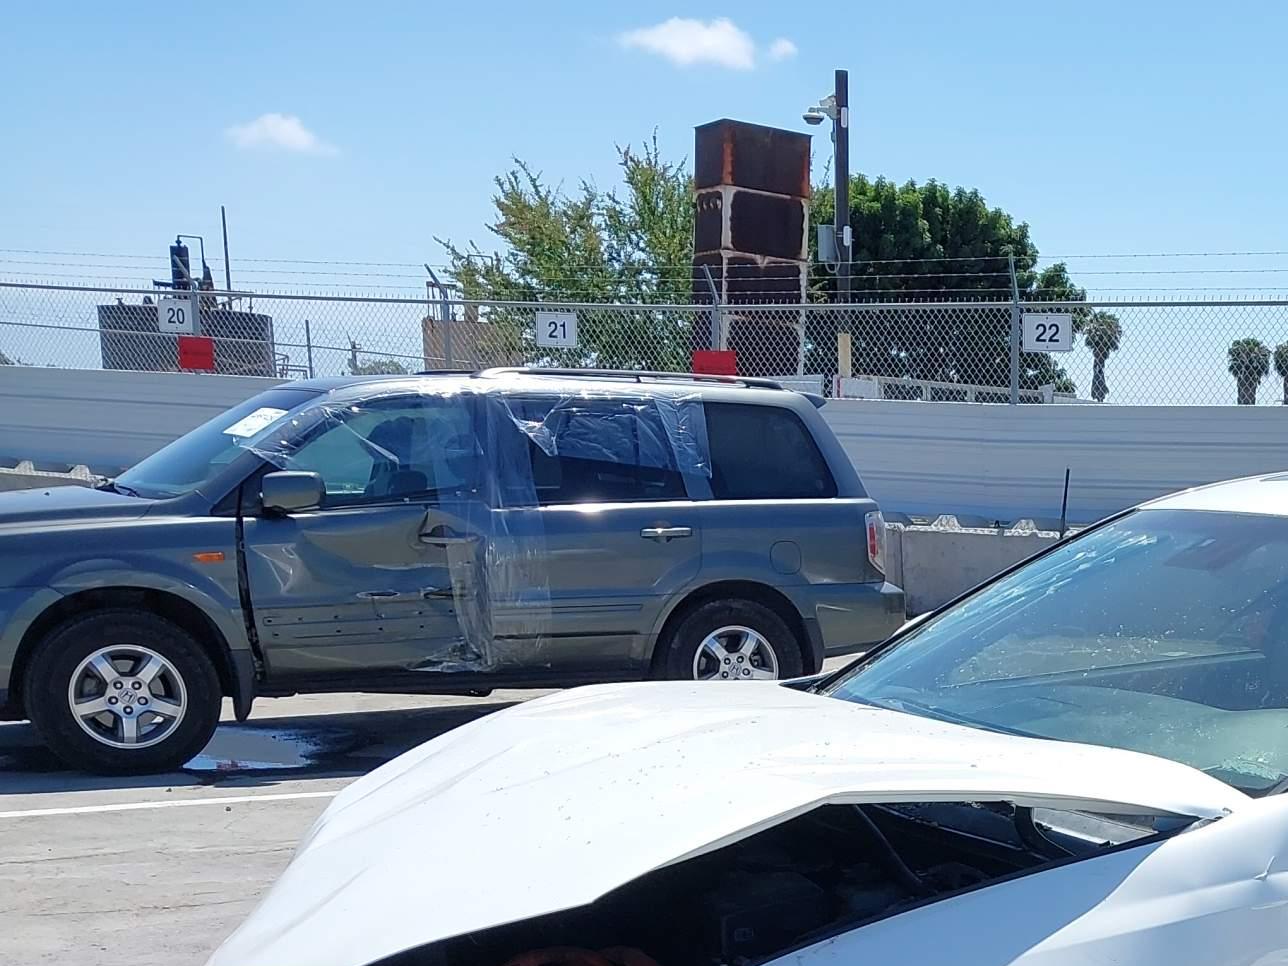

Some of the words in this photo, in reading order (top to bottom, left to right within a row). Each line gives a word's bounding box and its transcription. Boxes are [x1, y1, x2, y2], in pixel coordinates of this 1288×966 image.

[167, 307, 185, 325] 20
[548, 320, 566, 339] 21
[1035, 323, 1060, 343] 22
